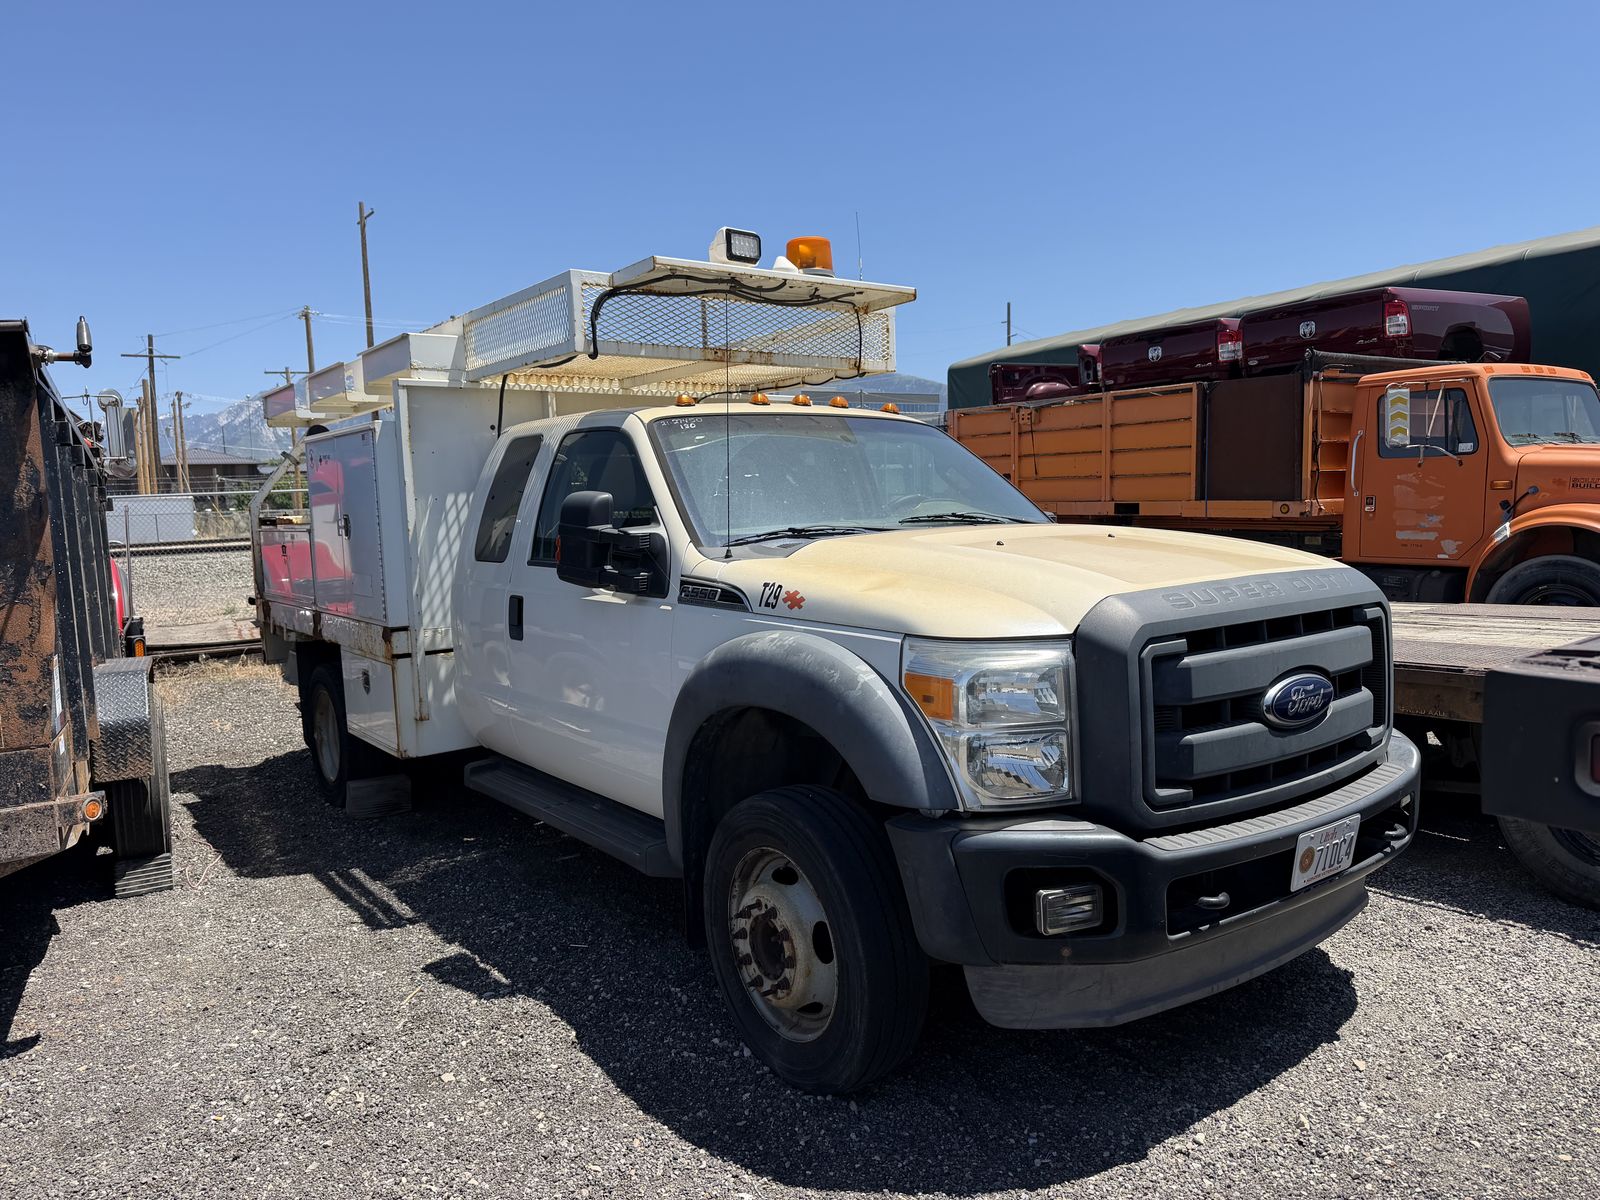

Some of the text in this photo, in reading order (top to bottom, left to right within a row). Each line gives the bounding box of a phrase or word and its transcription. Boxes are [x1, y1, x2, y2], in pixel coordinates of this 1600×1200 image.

[758, 582, 783, 609] T29
[1161, 580, 1286, 610] SUPER
[1287, 572, 1353, 594] DUTY
[1287, 683, 1325, 717] Ford
